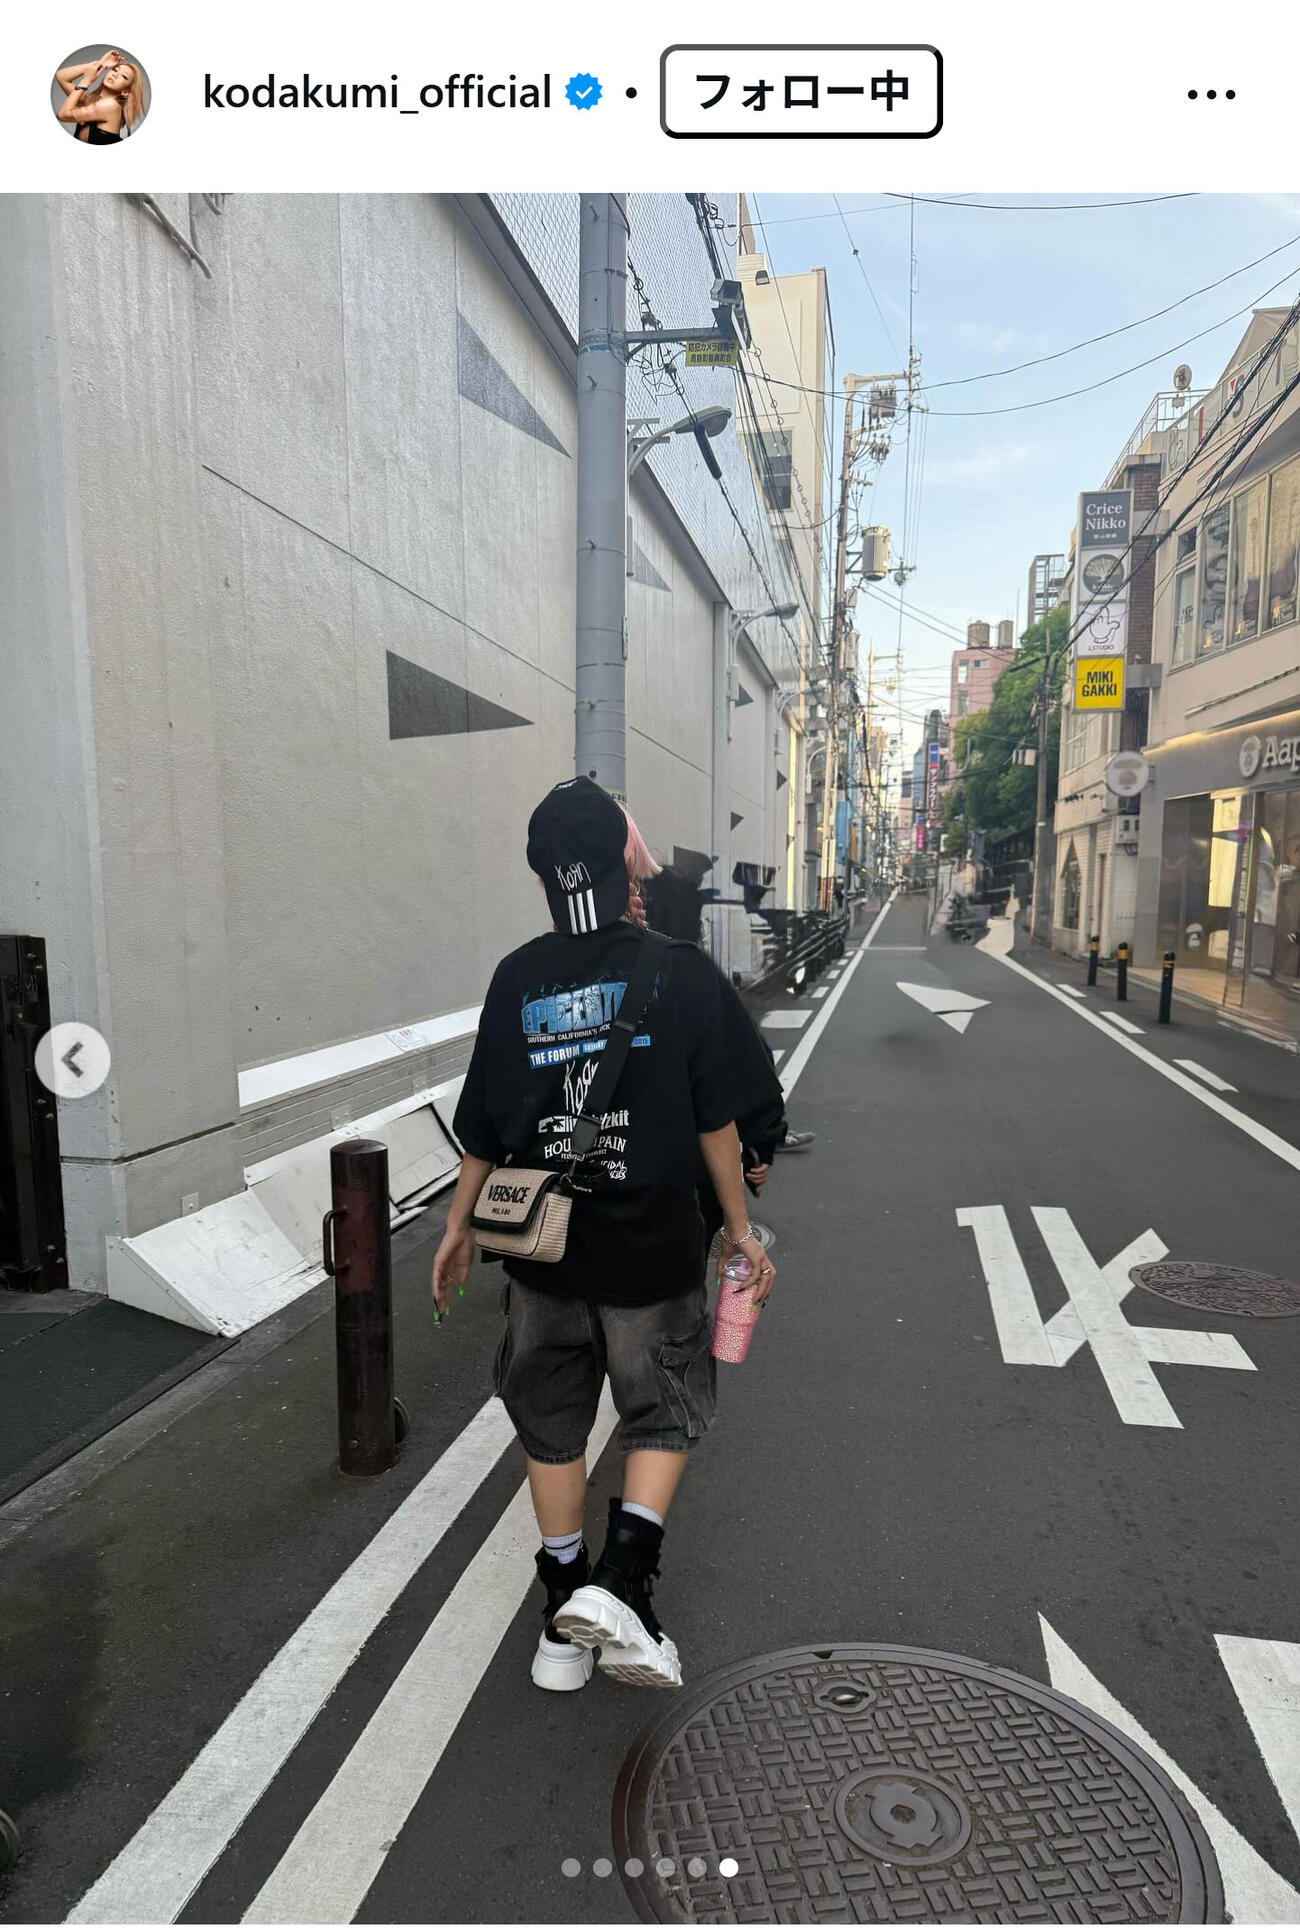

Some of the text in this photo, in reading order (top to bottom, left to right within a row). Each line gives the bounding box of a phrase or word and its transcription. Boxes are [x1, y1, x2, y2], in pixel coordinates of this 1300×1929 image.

[1086, 503, 1122, 515] Crice
[1085, 518, 1126, 530] Nikko
[1086, 671, 1113, 683] MIKI
[1082, 684, 1117, 697] GAKKI
[527, 1034, 556, 1043] SOUTHERN
[530, 1053, 546, 1066] THE
[547, 1045, 580, 1062] FORUM
[487, 1185, 530, 1204] VERSACE
